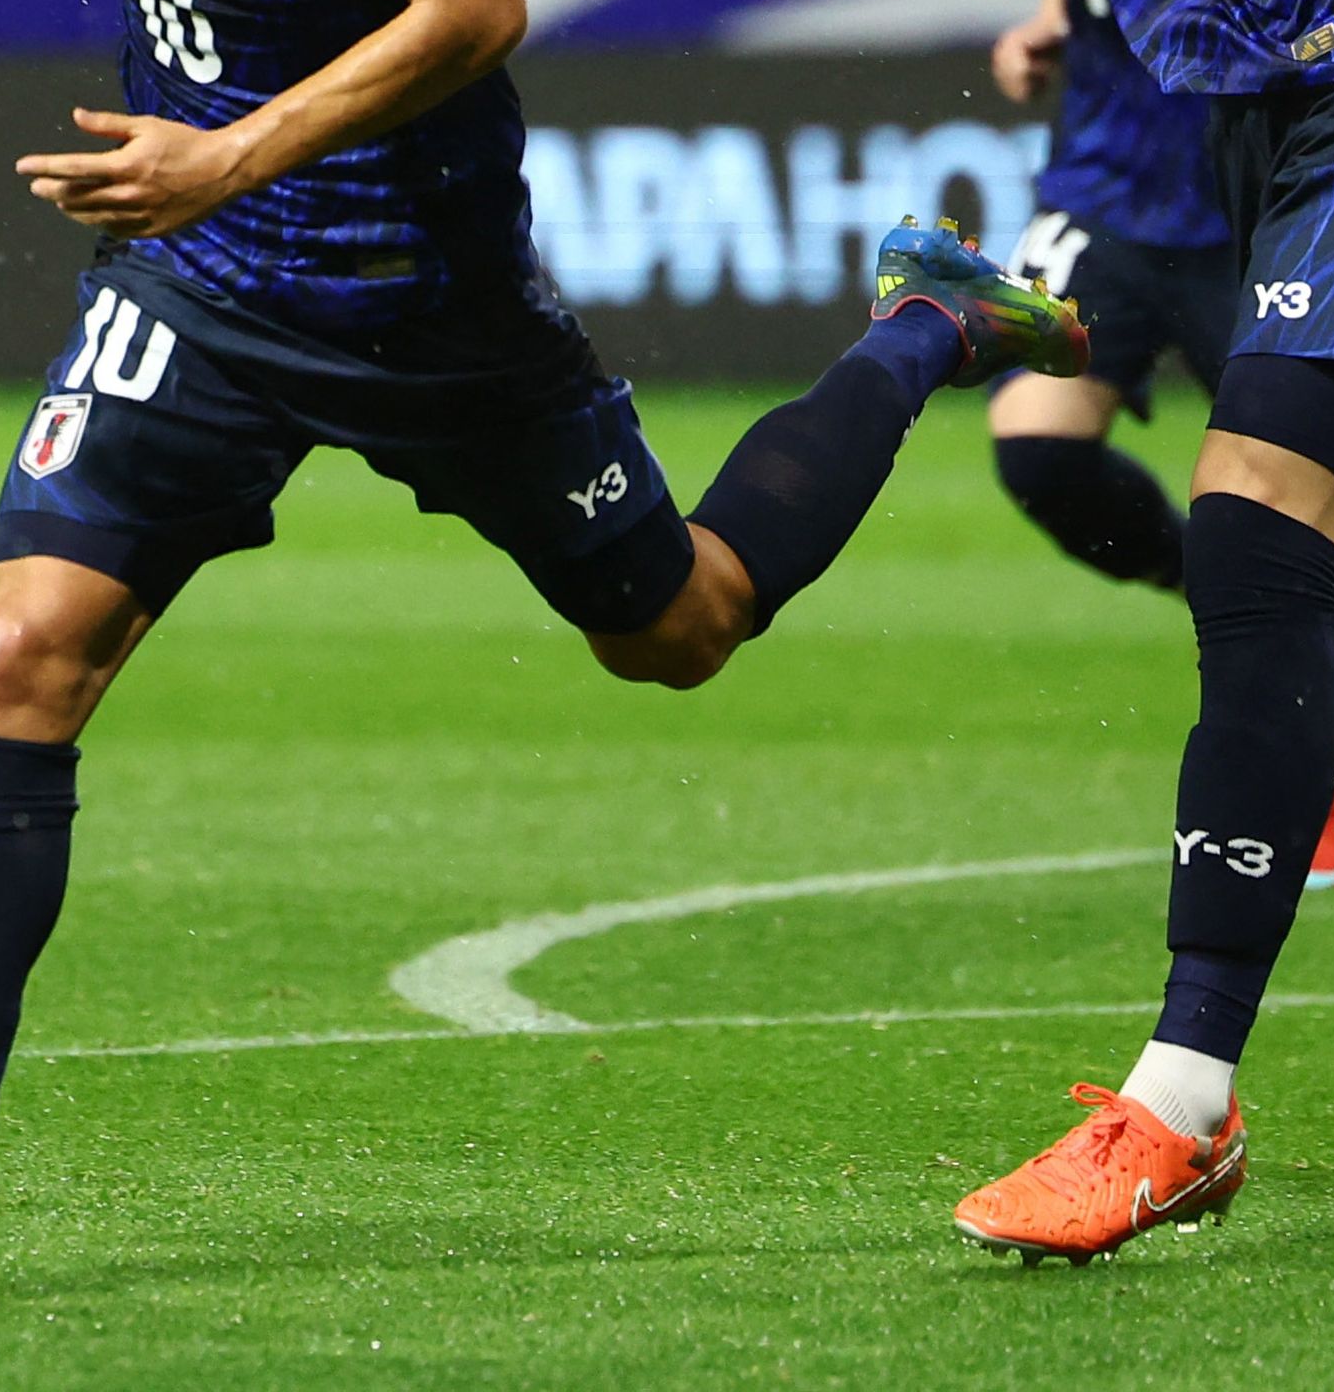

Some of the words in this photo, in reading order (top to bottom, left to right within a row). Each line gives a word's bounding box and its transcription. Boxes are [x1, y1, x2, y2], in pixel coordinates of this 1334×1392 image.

[1254, 281, 1312, 319] Y-3
[567, 461, 629, 520] Y-3
[1173, 829, 1275, 878] Y-3
